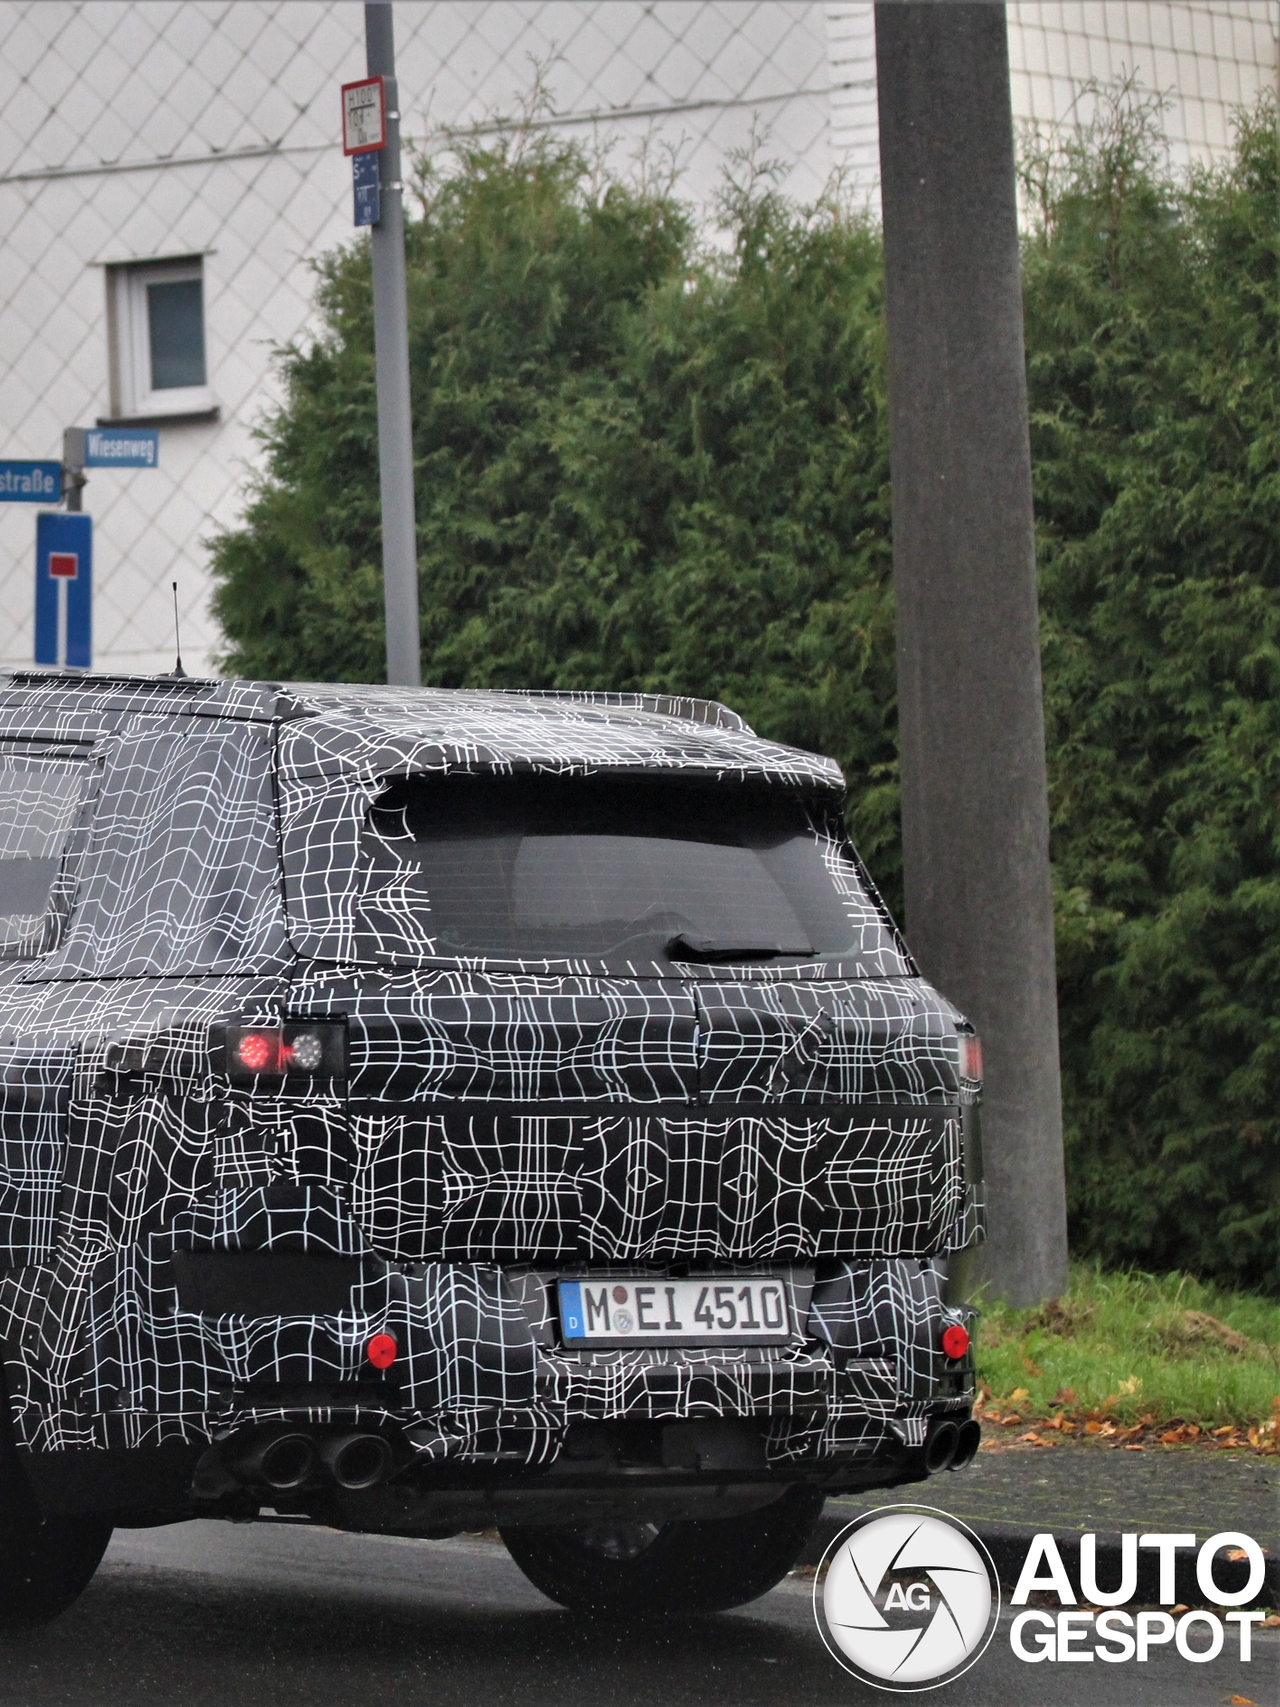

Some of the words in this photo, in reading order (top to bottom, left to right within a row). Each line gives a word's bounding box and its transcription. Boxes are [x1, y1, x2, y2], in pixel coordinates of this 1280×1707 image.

[87, 433, 155, 464] Wiesenweg
[569, 1316, 579, 1329] D
[584, 1287, 611, 1331] M
[635, 1287, 683, 1331] EI
[693, 1285, 783, 1330] 4510
